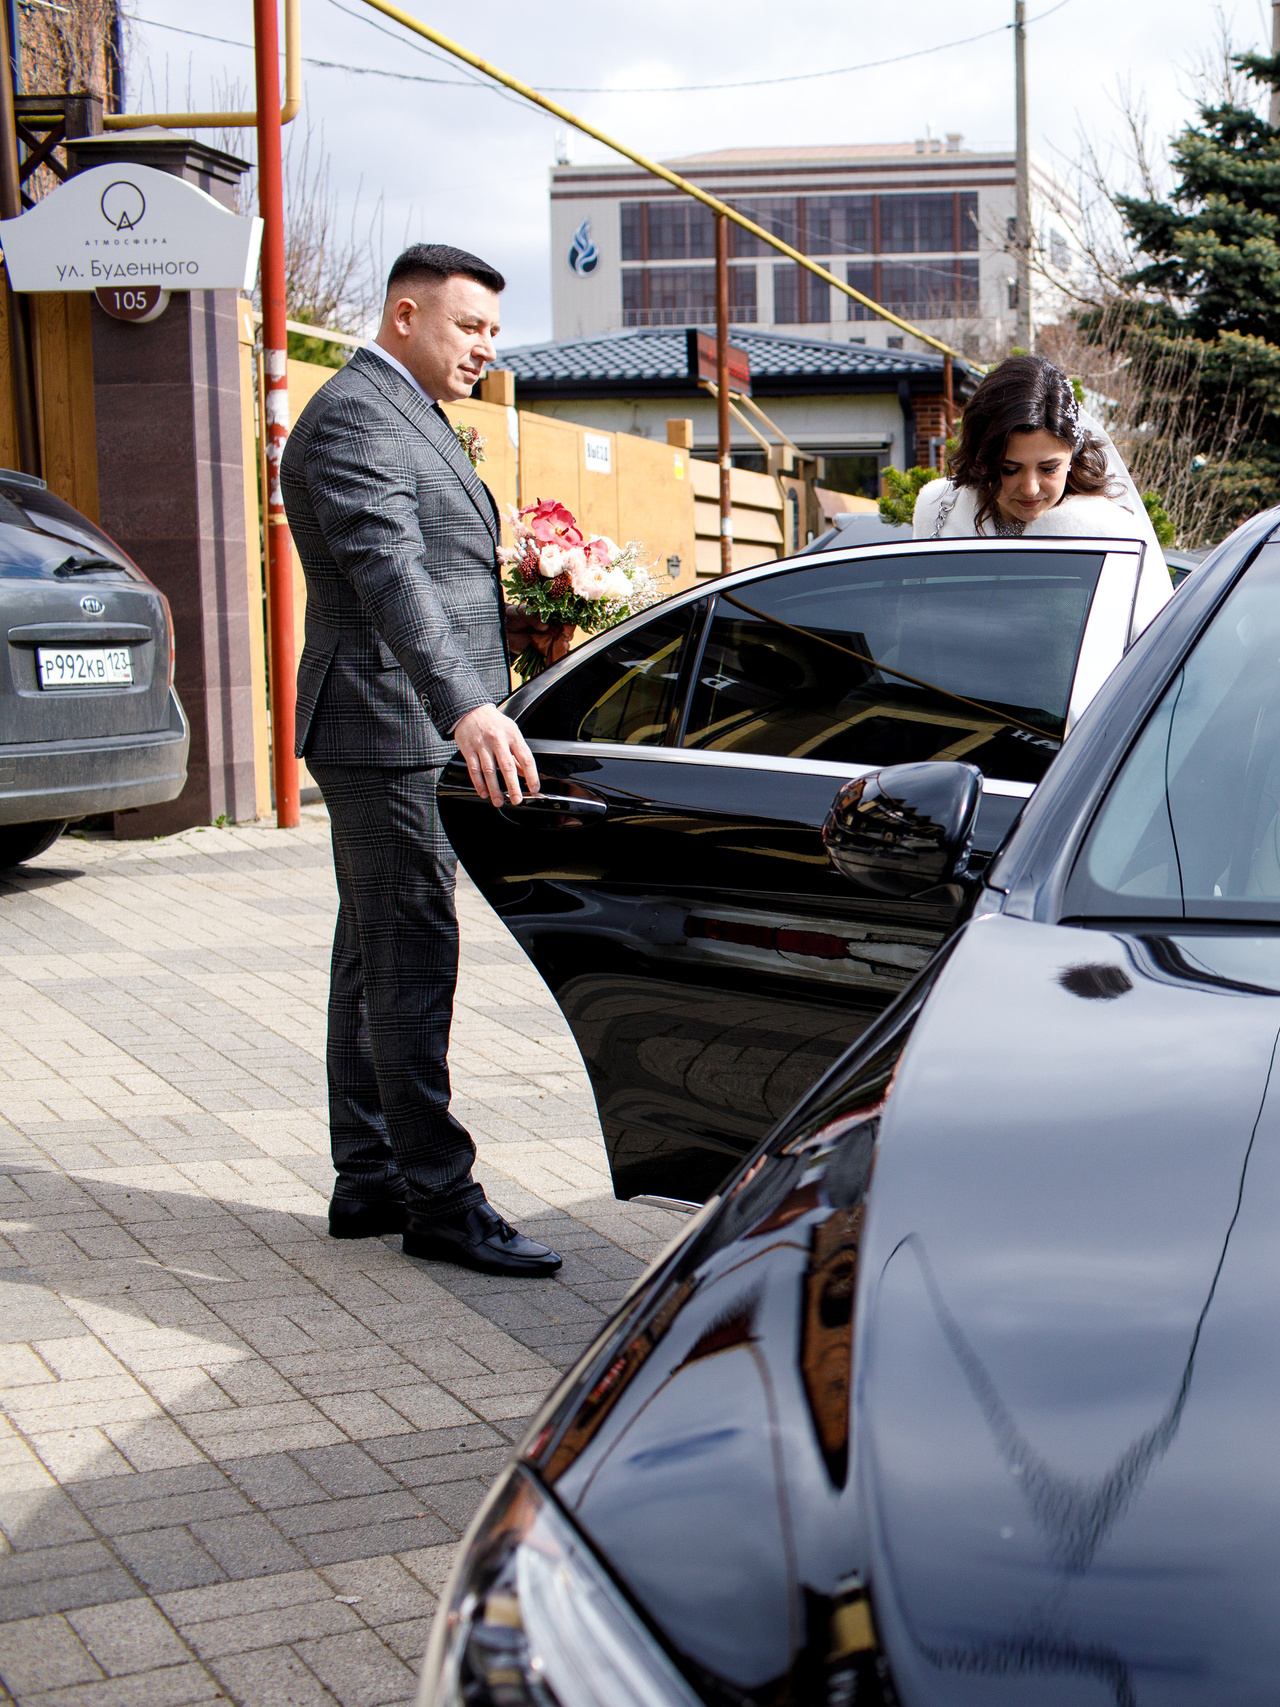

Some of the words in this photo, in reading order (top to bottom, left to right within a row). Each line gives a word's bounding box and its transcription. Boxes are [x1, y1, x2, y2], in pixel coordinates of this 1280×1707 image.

[84, 238, 168, 246] АТМОСФЕРА
[56, 264, 84, 281] ул.
[91, 259, 199, 280] Буденного
[113, 291, 147, 310] 105
[84, 599, 102, 612] KIA
[107, 652, 127, 670] 123
